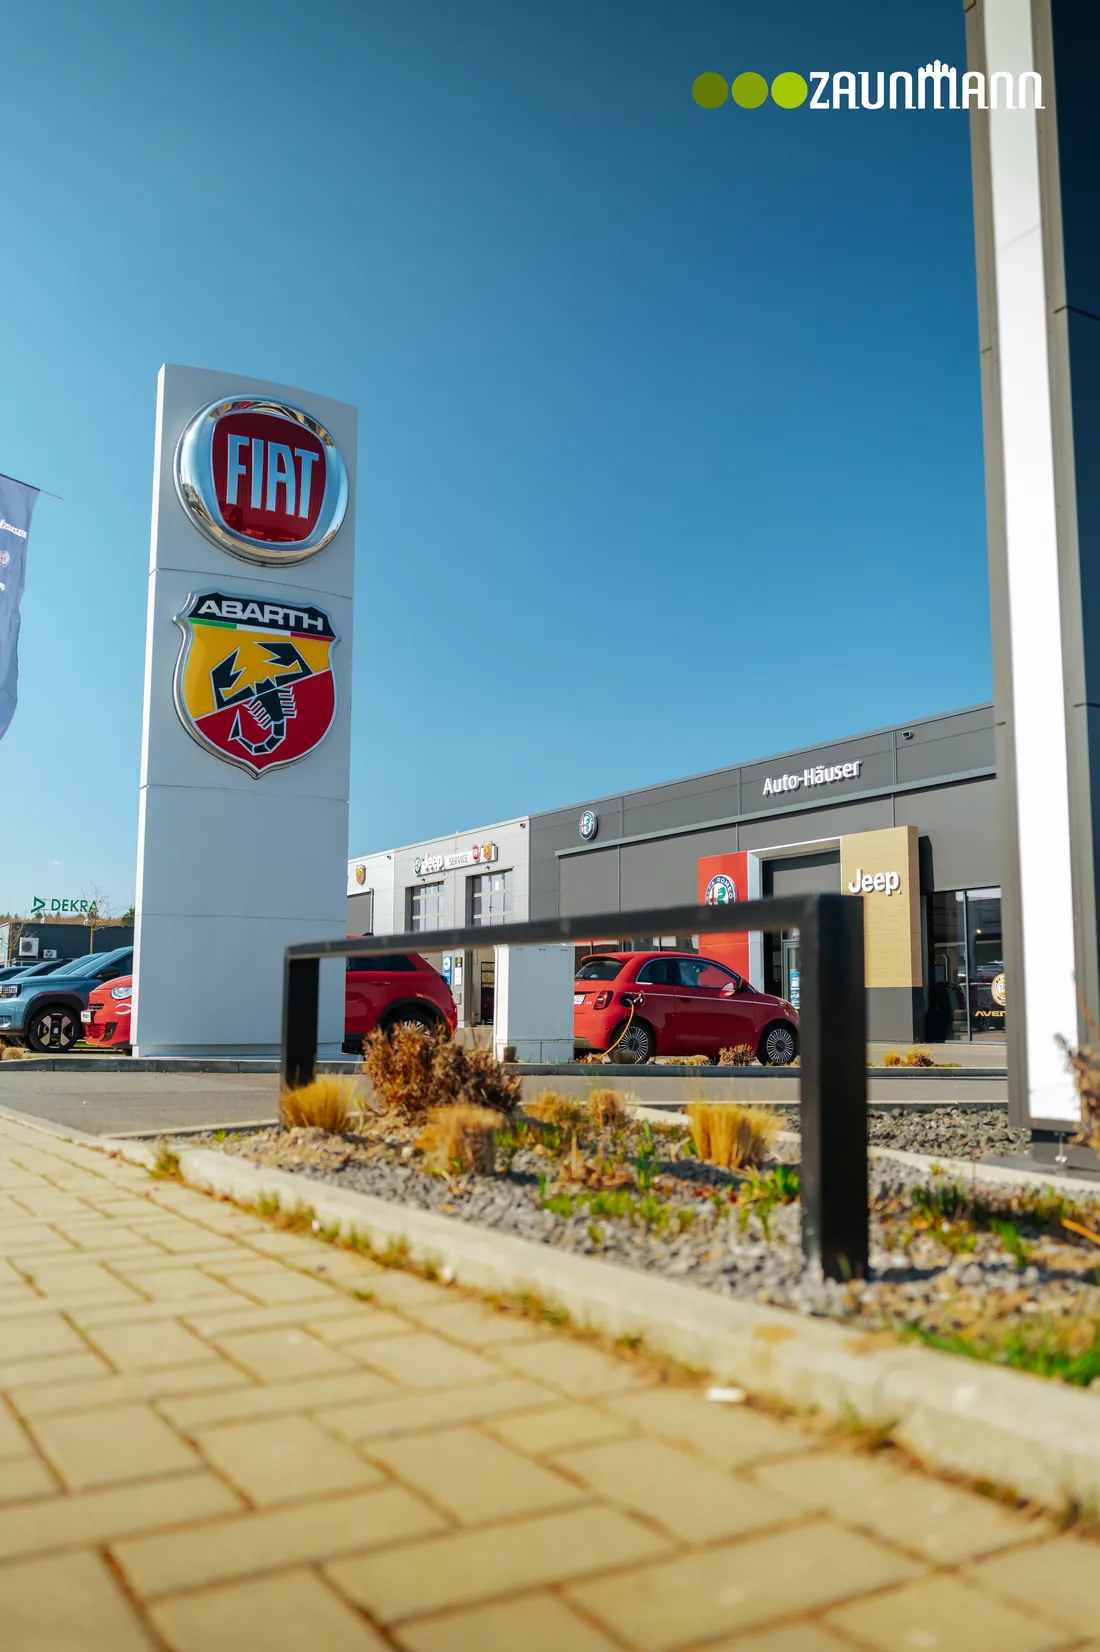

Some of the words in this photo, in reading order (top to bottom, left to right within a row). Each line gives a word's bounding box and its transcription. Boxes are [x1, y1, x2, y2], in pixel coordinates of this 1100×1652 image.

[226, 433, 320, 519] FIAT
[197, 600, 324, 631] ABARTH
[762, 760, 862, 796] Auto-Häuser
[421, 853, 444, 871] Jeep
[449, 855, 468, 867] SERVICE
[716, 877, 733, 899] ROMEO
[848, 868, 900, 896] Jeep
[51, 898, 98, 912] DEKRA
